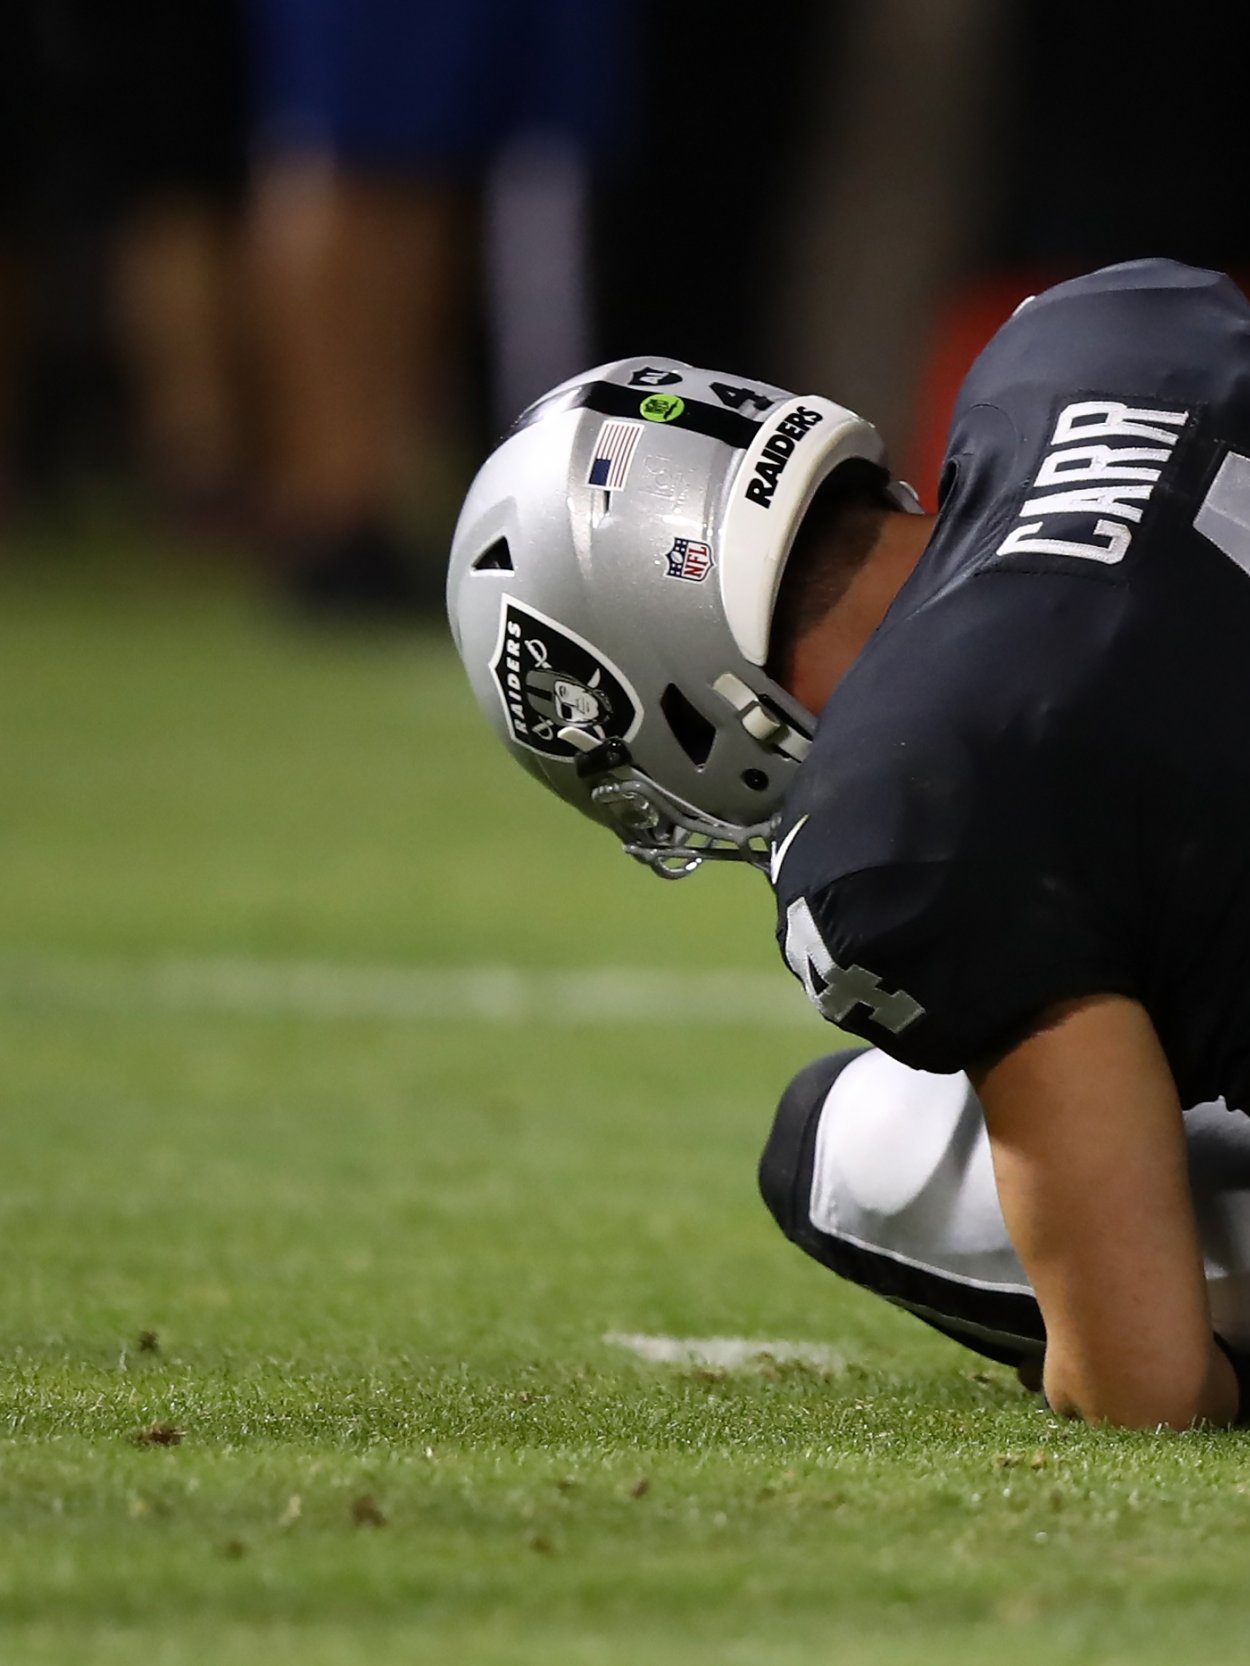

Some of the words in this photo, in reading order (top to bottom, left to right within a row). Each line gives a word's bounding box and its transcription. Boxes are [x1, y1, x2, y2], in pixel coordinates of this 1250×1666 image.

[708, 381, 775, 412] 4
[744, 405, 823, 509] RAIDERS
[996, 401, 1190, 565] CARR
[683, 546, 709, 578] NFL
[506, 620, 529, 735] RAIDERS
[785, 896, 927, 1034] 4
